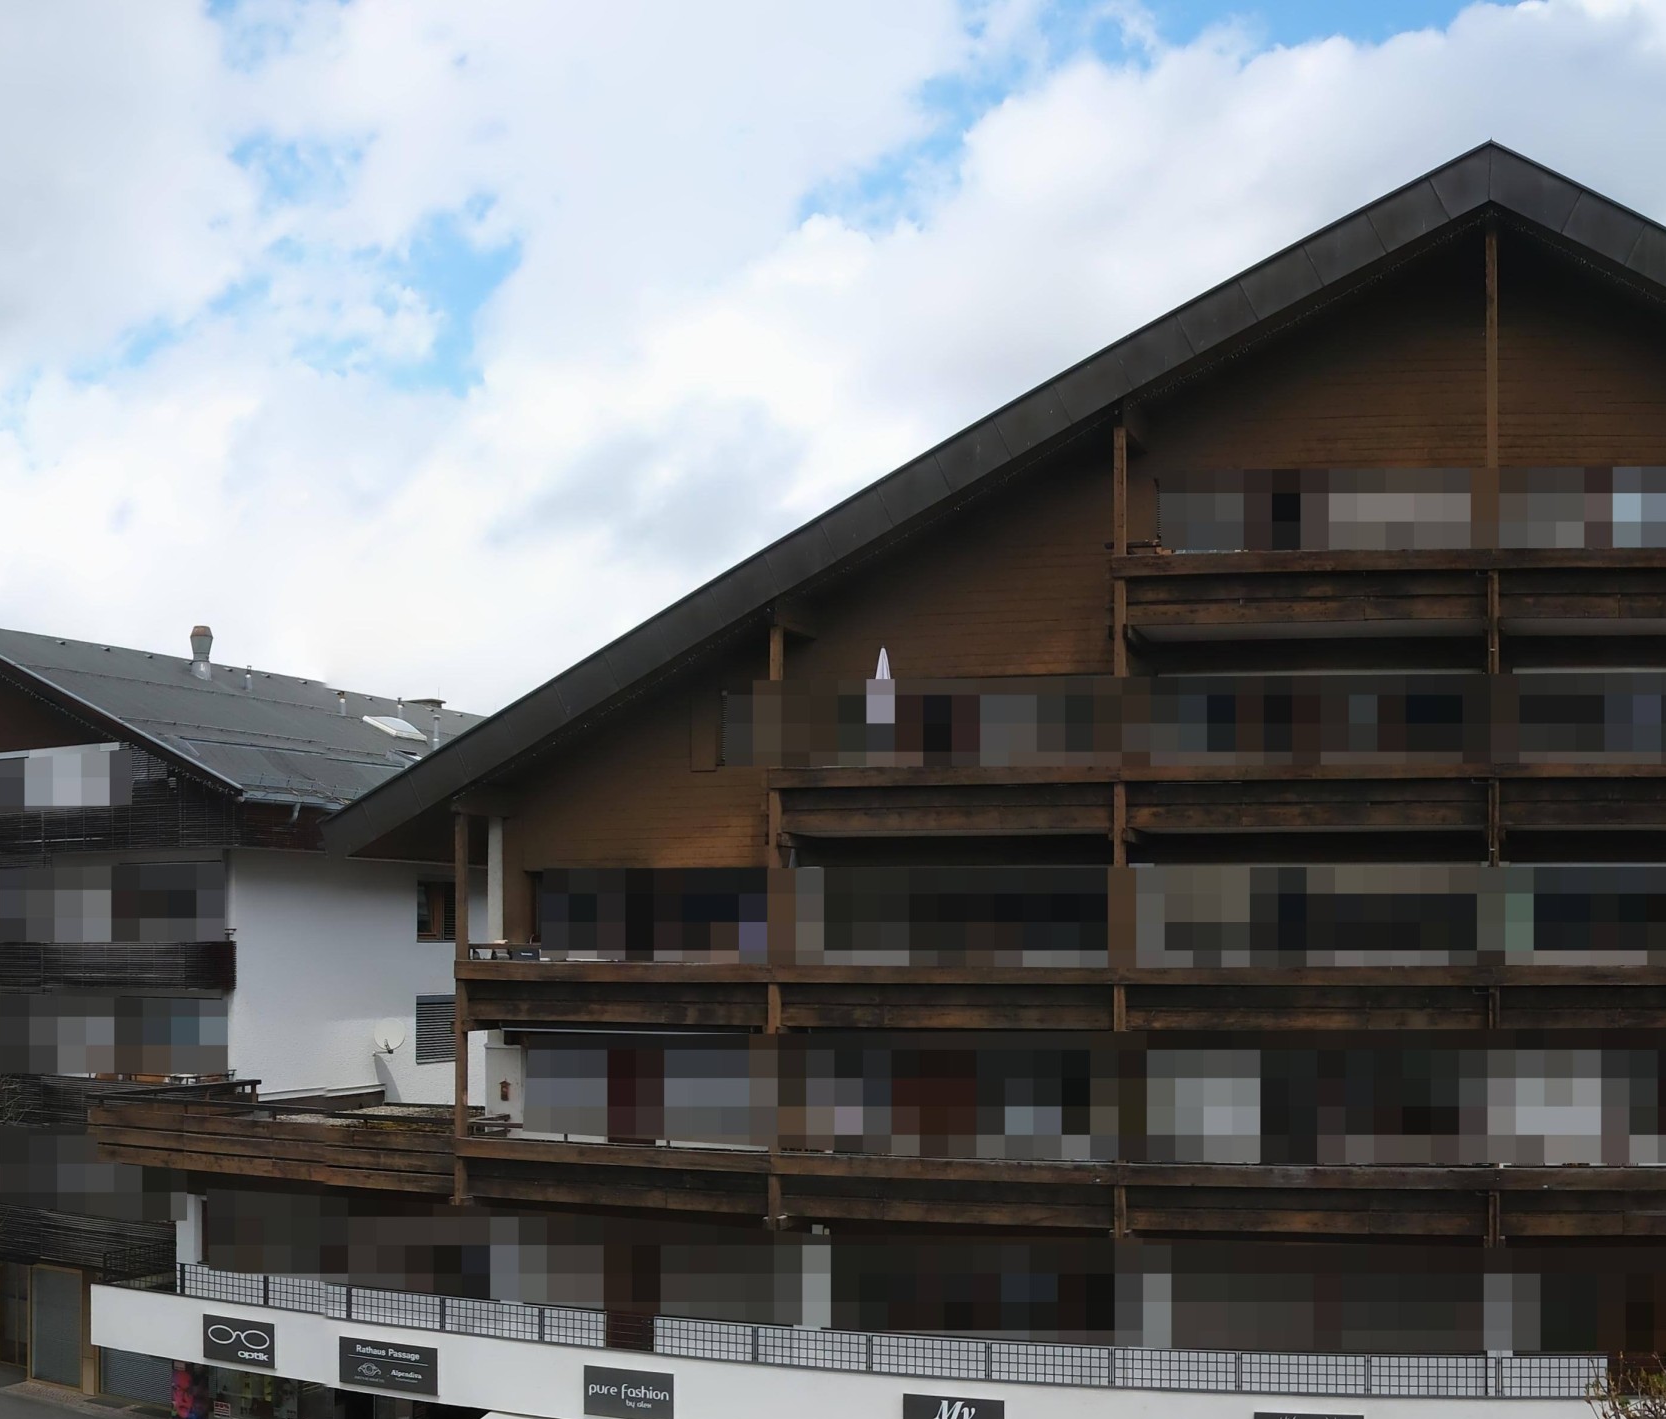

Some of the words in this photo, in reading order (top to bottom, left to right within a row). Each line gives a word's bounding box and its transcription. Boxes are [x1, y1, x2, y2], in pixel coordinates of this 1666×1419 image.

[238, 1350, 269, 1361] optik
[356, 1344, 386, 1356] Rathaus
[388, 1348, 420, 1361] Passage
[589, 1383, 618, 1396] pure
[621, 1383, 669, 1401] fashion
[625, 1400, 636, 1409] by
